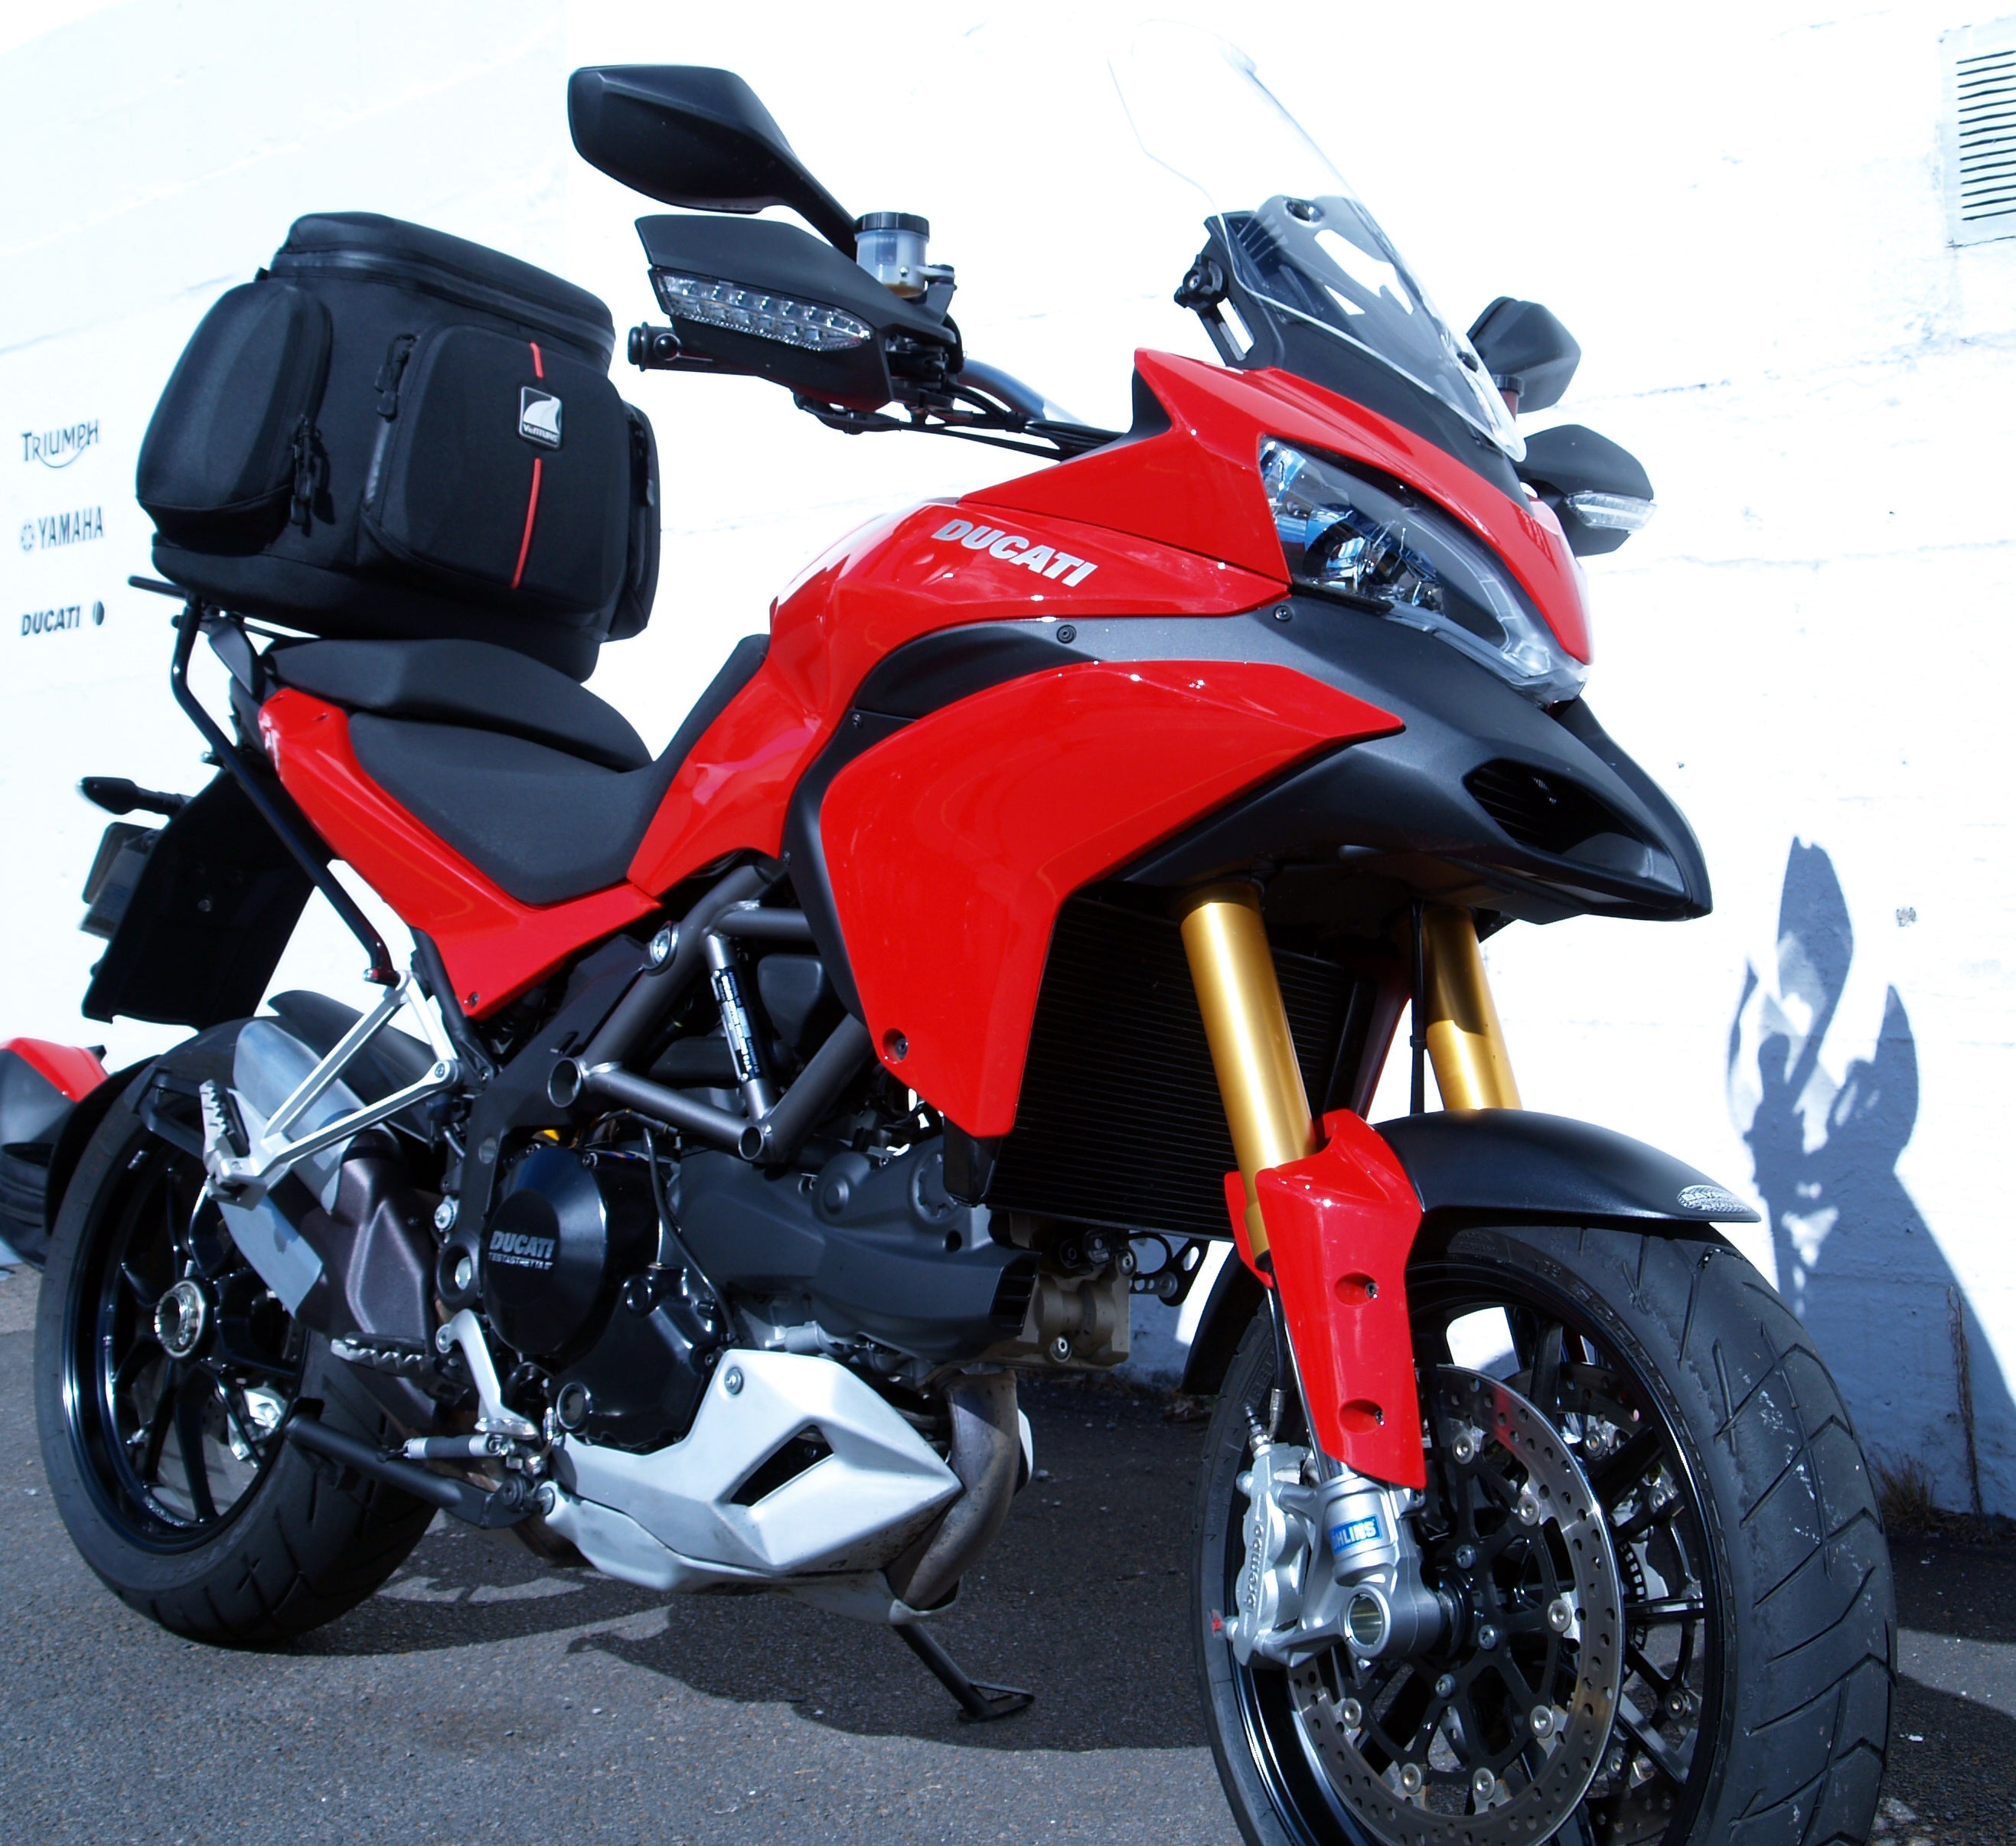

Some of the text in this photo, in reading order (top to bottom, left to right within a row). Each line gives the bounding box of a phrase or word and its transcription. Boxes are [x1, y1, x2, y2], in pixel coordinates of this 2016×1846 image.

[21, 419, 99, 464] TRIUMPH
[38, 506, 103, 550] YAMAHA
[931, 519, 1098, 588] DUCATI
[21, 605, 80, 636] DUCATI
[489, 1231, 556, 1260] DUCATI
[1244, 1523, 1264, 1612] brembo
